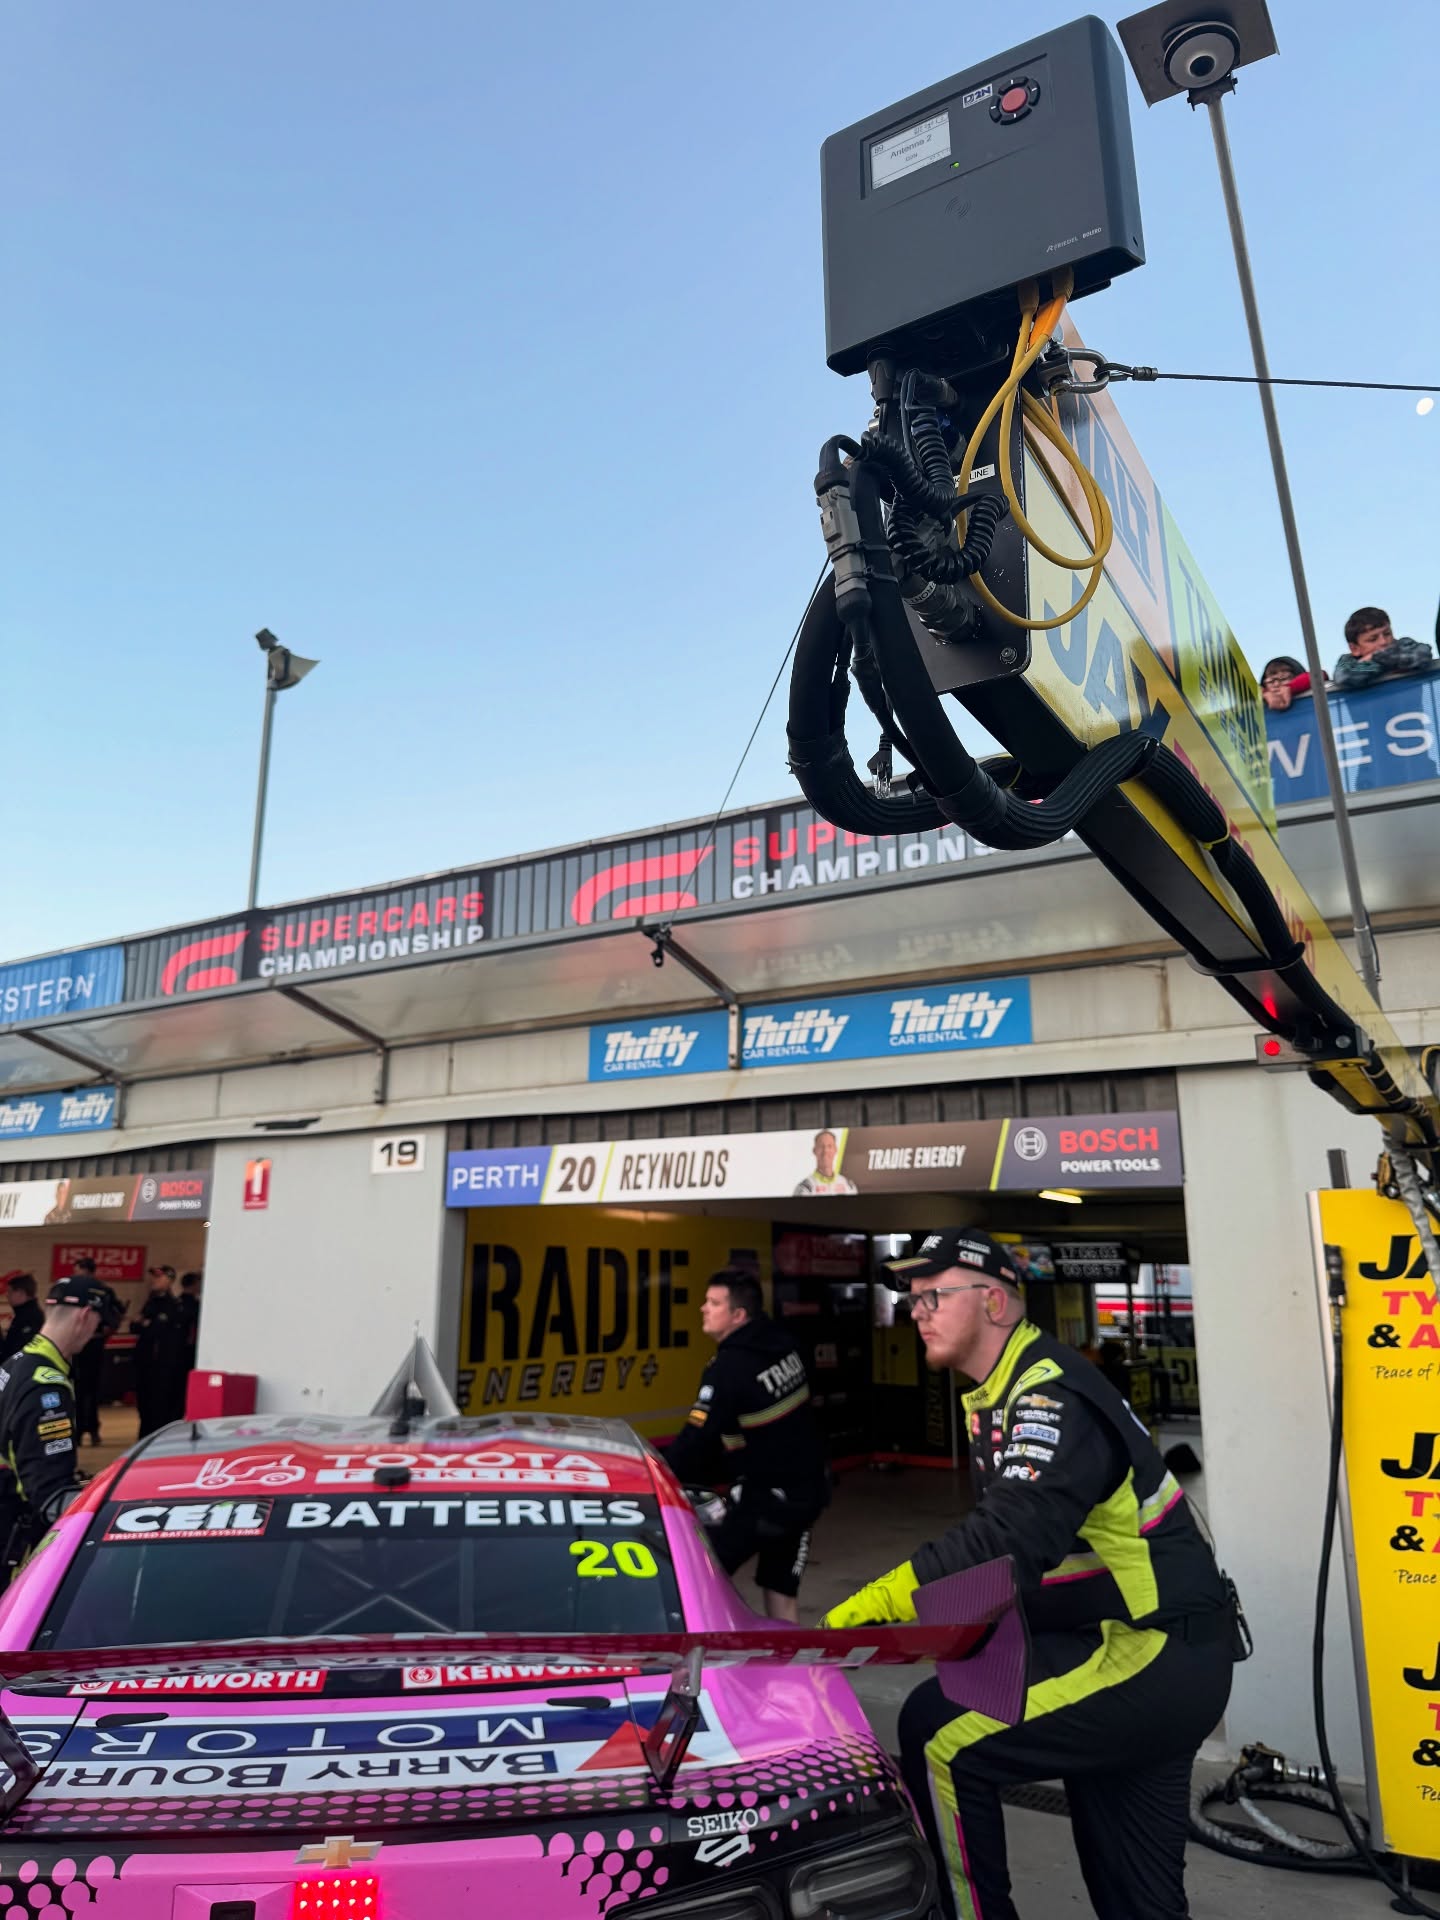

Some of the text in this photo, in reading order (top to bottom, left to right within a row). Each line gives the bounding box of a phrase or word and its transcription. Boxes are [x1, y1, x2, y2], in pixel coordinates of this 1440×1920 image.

[890, 138, 925, 159] Antenna
[926, 134, 932, 142] 2
[260, 891, 485, 952] SUPERCARS
[259, 925, 485, 979] CHAMPIONSHIP
[0, 972, 96, 1013] STERN
[890, 991, 1013, 1039] Thrifty
[742, 1009, 850, 1053] Thrifty
[889, 1031, 967, 1047] CAR RENTAL
[604, 1025, 699, 1067] Thrifty
[742, 1045, 810, 1060] CAR RENTAL
[604, 1059, 664, 1073] CAR RENTAL
[60, 1092, 114, 1125] Thrifty
[379, 1139, 418, 1167] 19
[452, 1127, 1159, 1193] PERTH 20 REYNOLDS TRADIE ENERGY BOSCH
[1060, 1157, 1161, 1174] POWER TOOLS
[160, 1180, 203, 1197] BOSCH
[1367, 1323, 1401, 1349] &
[1417, 1362, 1434, 1381] of
[320, 1451, 605, 1473] TOYOTA
[286, 1499, 646, 1529] BATTERIES
[108, 1531, 160, 1541] TRUSTED
[1390, 1525, 1425, 1553] &
[568, 1540, 660, 1580] 20
[117, 1670, 321, 1689] KENWORTH
[306, 1749, 560, 1781] BARRY
[687, 1808, 759, 1838] SEIKO
